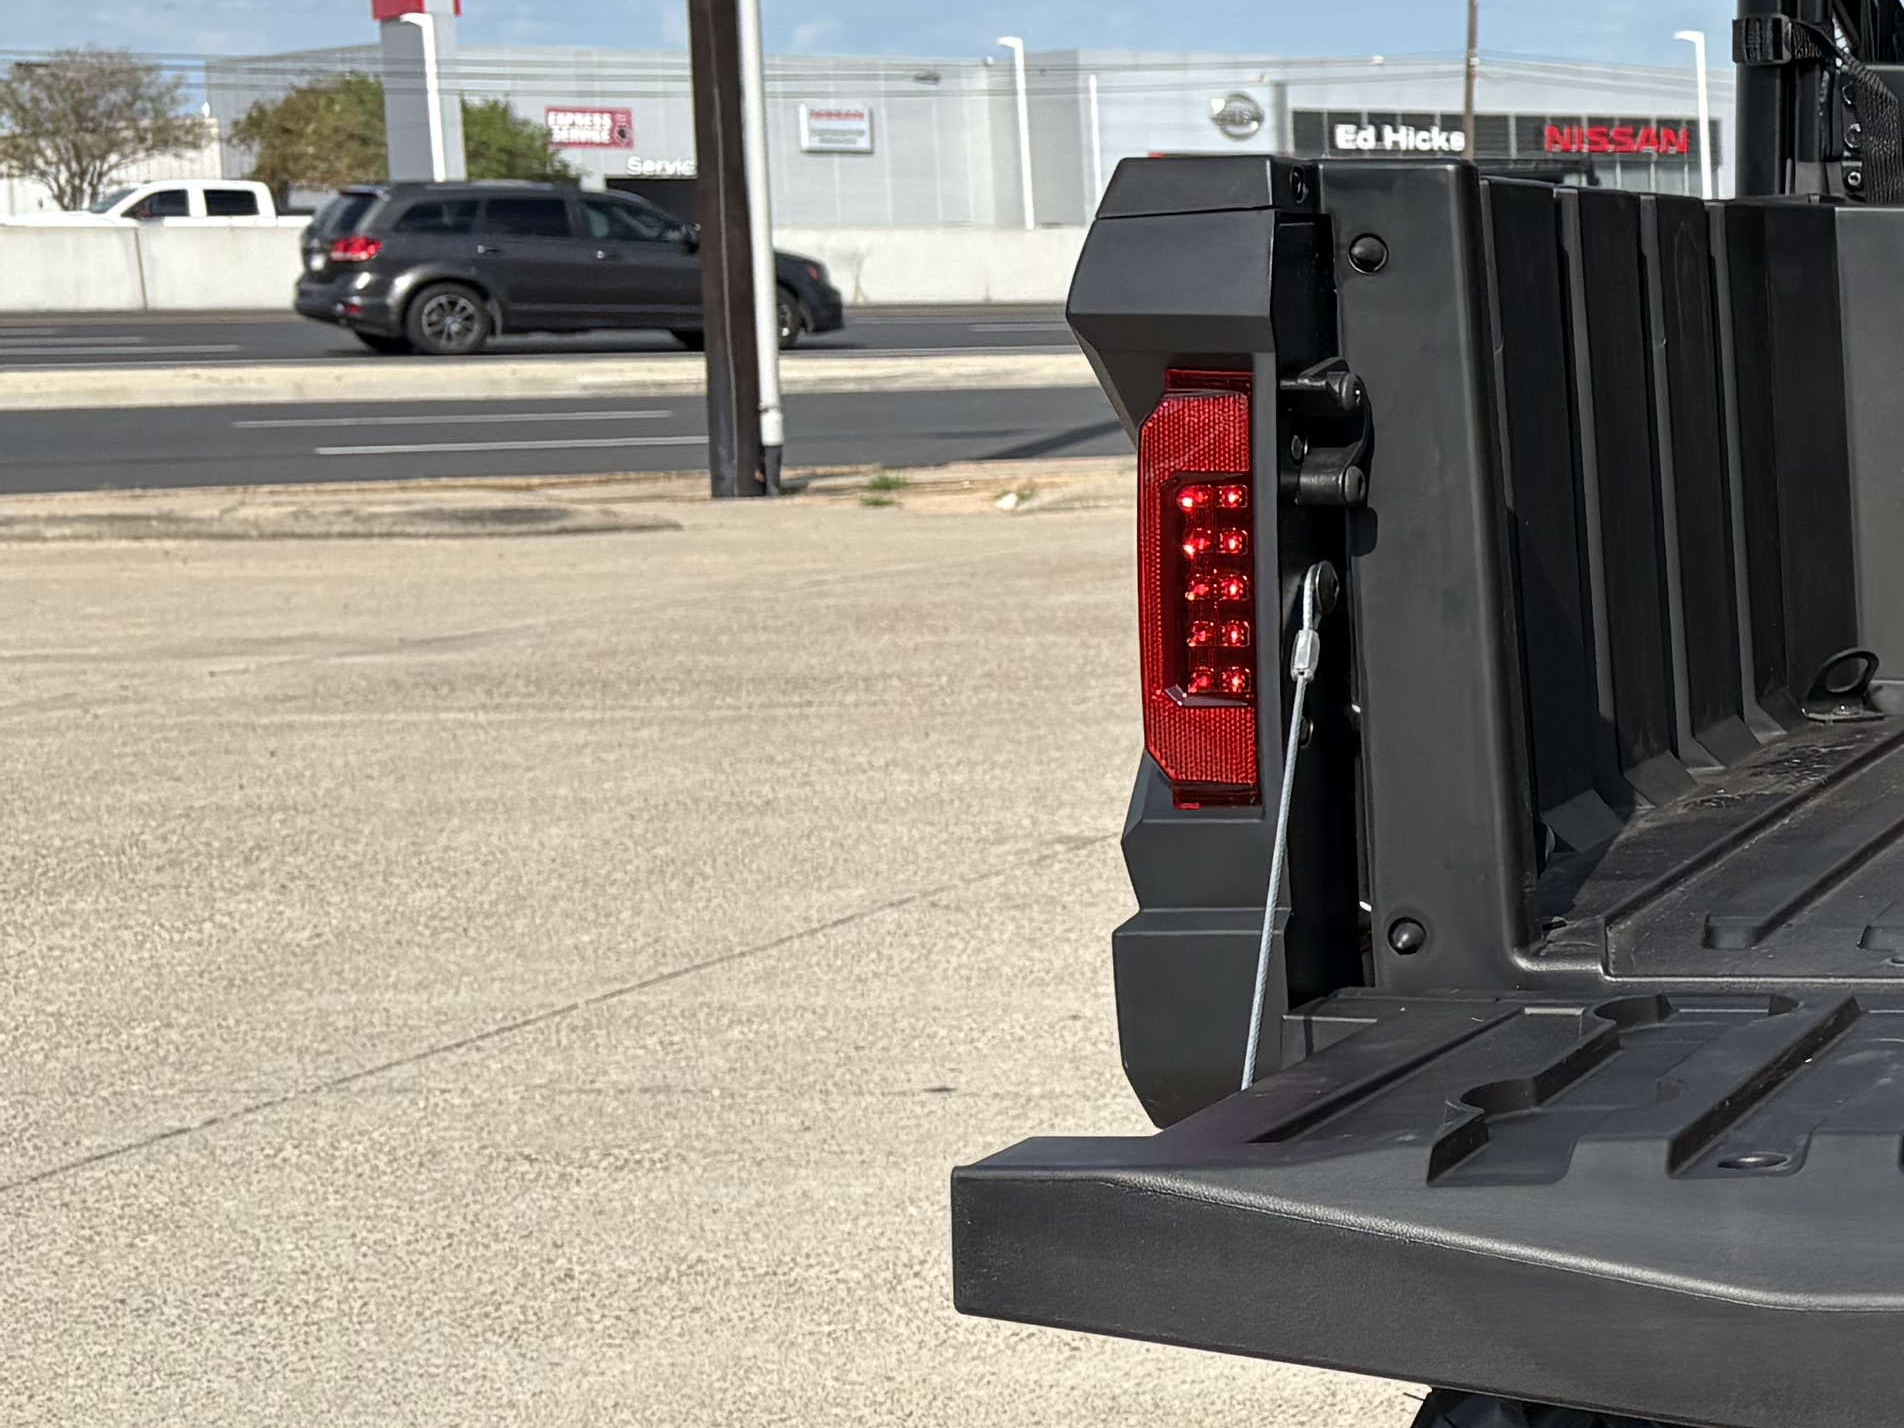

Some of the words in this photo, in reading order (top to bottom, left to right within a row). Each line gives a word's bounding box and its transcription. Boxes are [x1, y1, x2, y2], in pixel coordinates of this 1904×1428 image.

[1334, 123, 1375, 150] Ed
[1543, 124, 1690, 154] NISSAN
[627, 156, 697, 176] Servic
